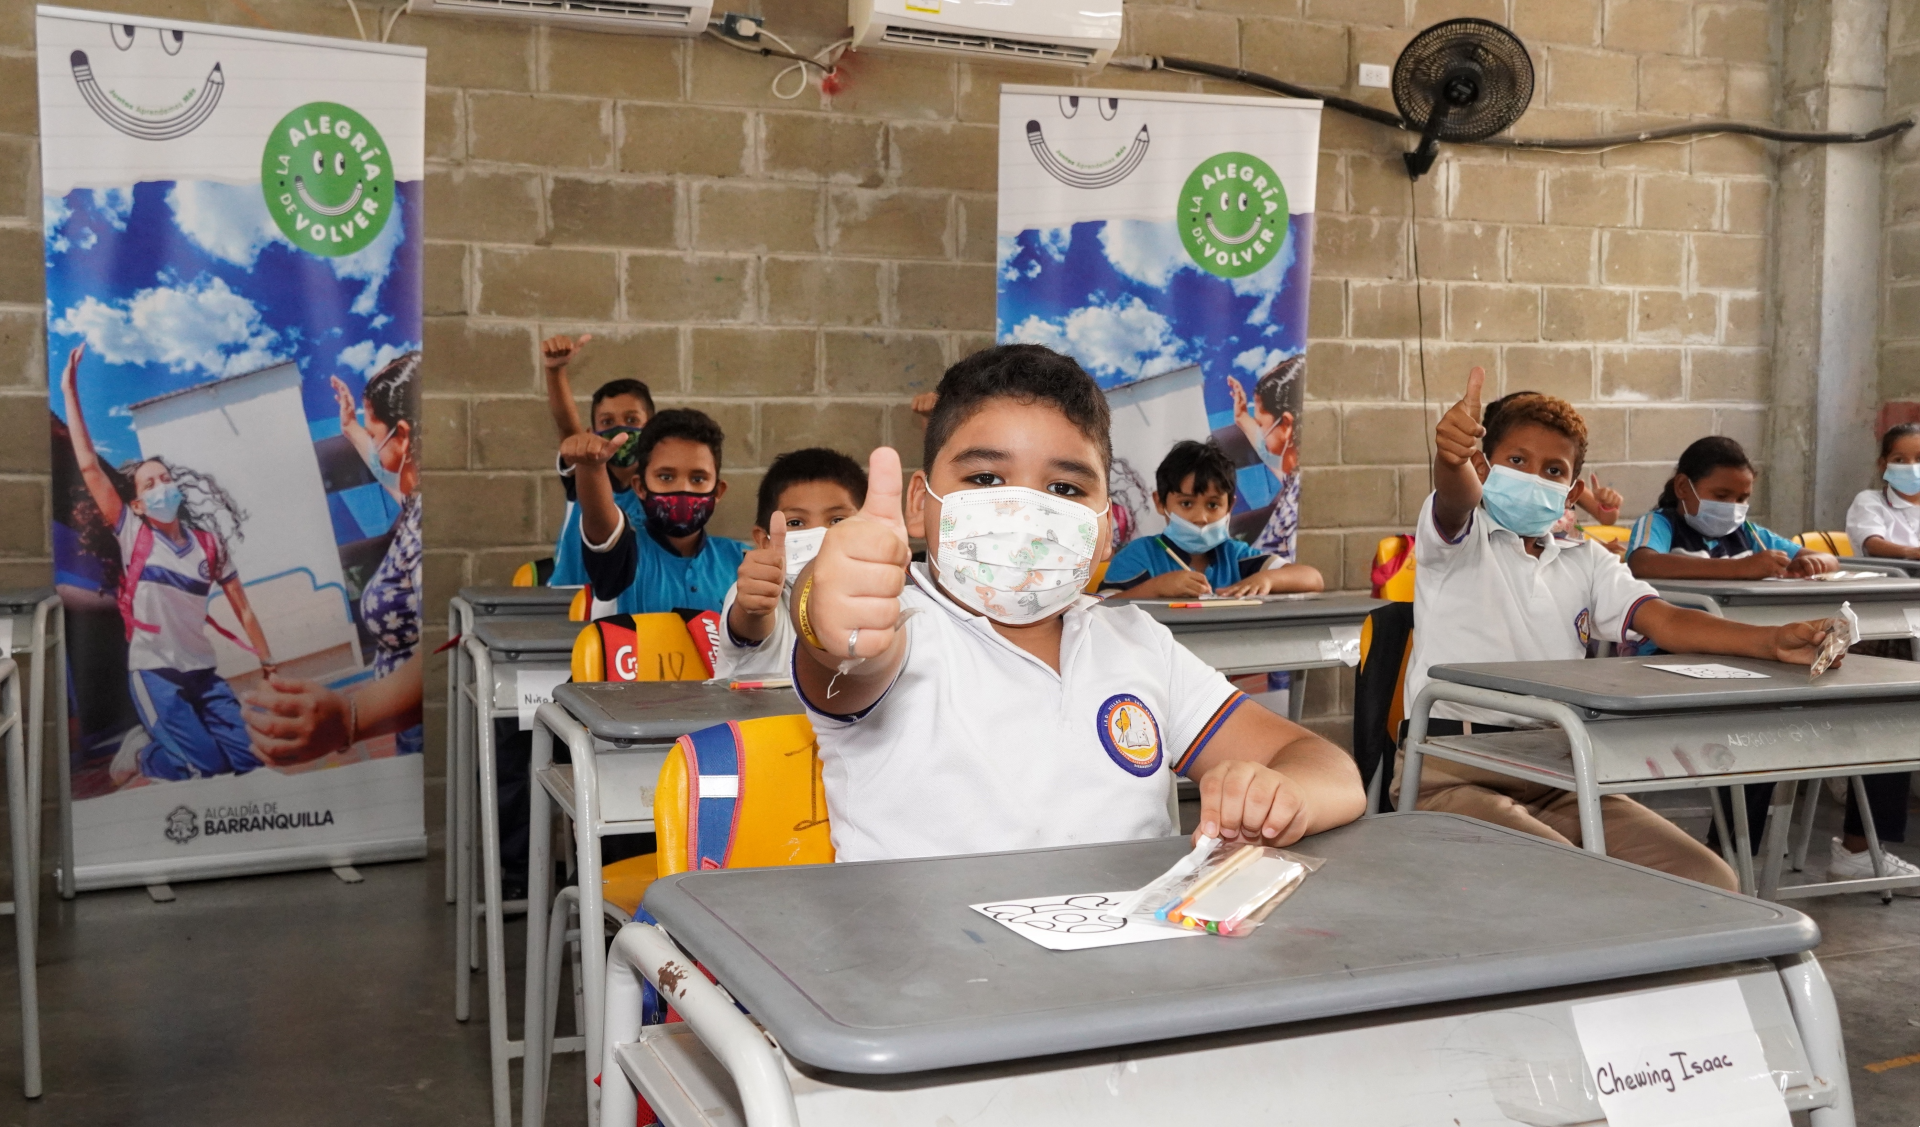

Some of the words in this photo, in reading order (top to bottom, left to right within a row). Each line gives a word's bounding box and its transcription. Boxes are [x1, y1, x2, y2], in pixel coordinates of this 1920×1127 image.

[276, 155, 291, 175] LA
[289, 115, 381, 181] ALEGRÍA
[1190, 196, 1203, 213] LA
[1202, 163, 1279, 215] ALEGRÍA
[280, 192, 297, 215] DE
[295, 197, 379, 243] VOLVER
[1192, 227, 1206, 245] DE
[1204, 228, 1274, 266] VOLVER
[204, 802, 260, 819] ALCALDÍA
[263, 802, 278, 814] DE
[204, 809, 334, 836] BARRANQUILLA
[1596, 1061, 1676, 1095] Chewing
[1669, 1051, 1733, 1081] Isaac
